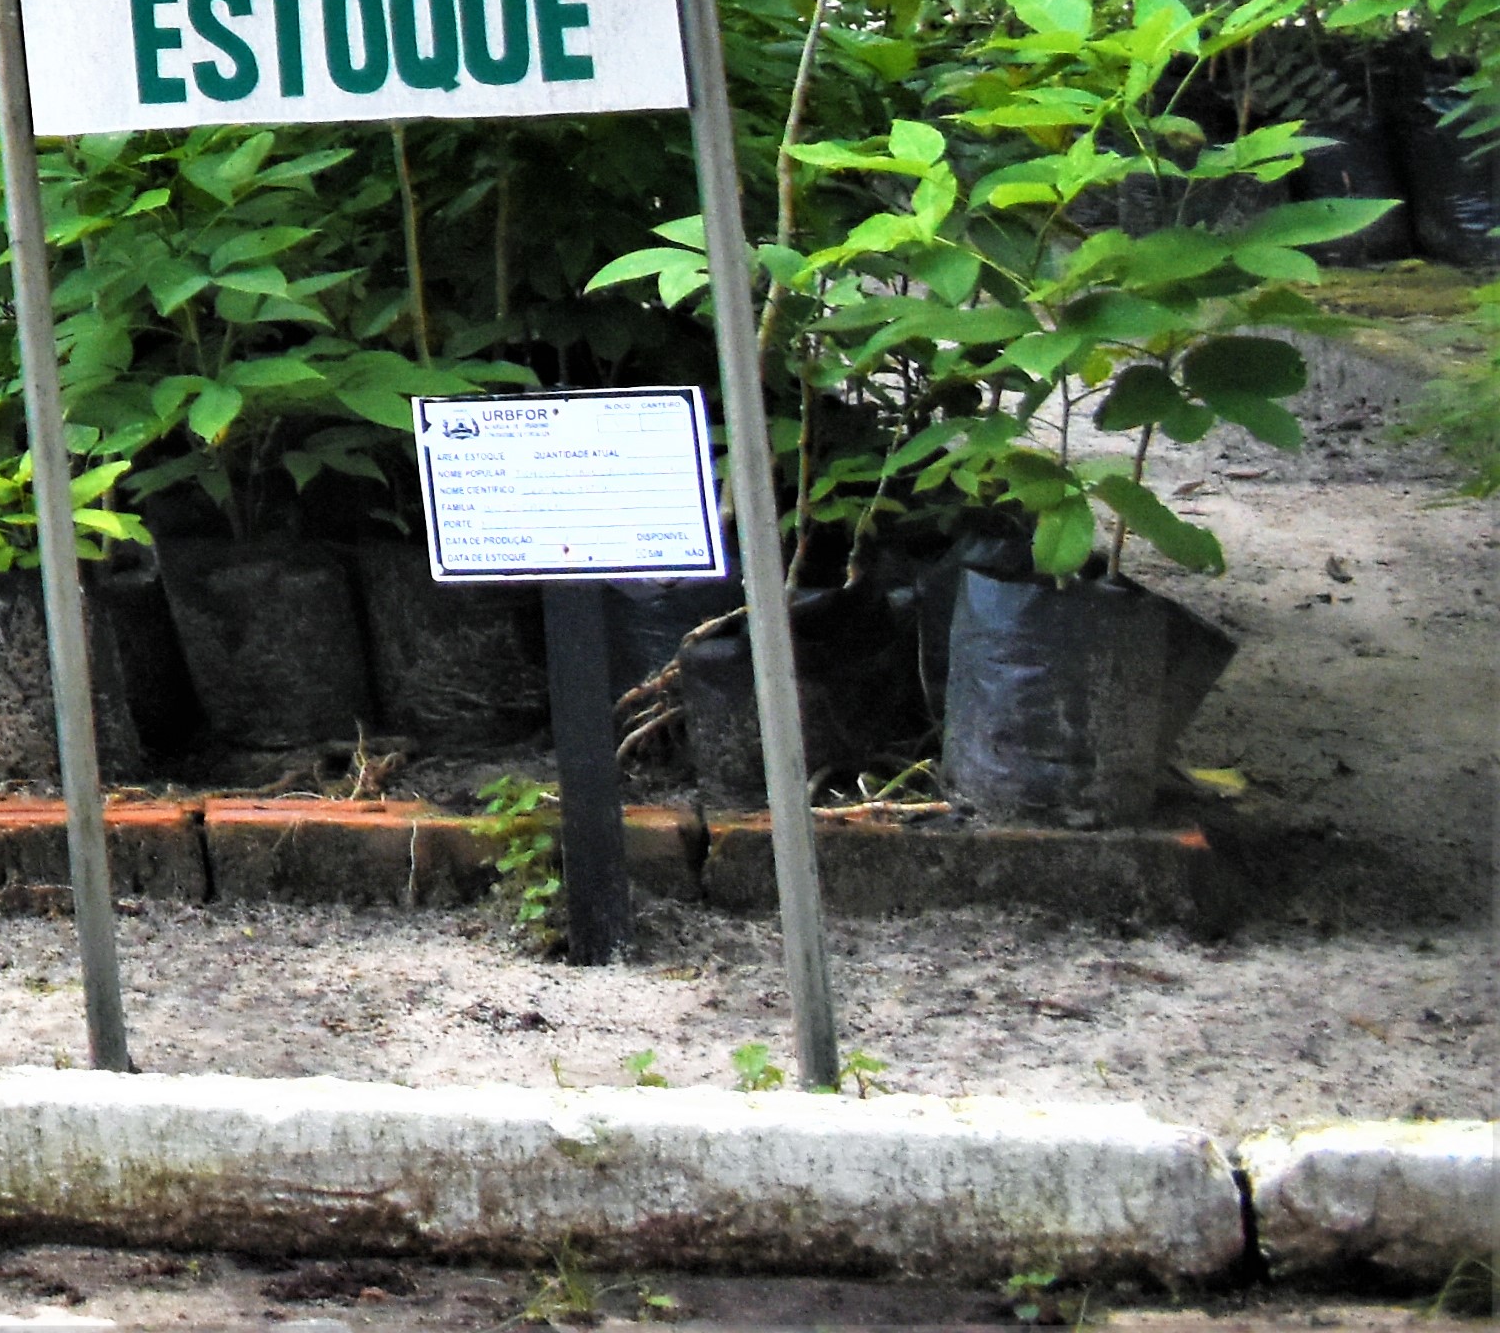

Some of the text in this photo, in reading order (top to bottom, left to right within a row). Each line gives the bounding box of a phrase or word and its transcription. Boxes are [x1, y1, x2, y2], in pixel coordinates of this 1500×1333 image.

[640, 401, 681, 409] CANTEIRO
[482, 408, 548, 422] URBFOR
[465, 451, 506, 461] ESTOQUE
[533, 449, 620, 460] QUANTIDADE ATUAL
[438, 469, 462, 478] NOME
[465, 468, 506, 478] POPULAR
[440, 486, 465, 495] NOME
[443, 519, 472, 528] PORTE
[445, 536, 468, 545] DATA
[470, 536, 481, 545] DE
[447, 552, 527, 562] DATA DE ESTOQUE
